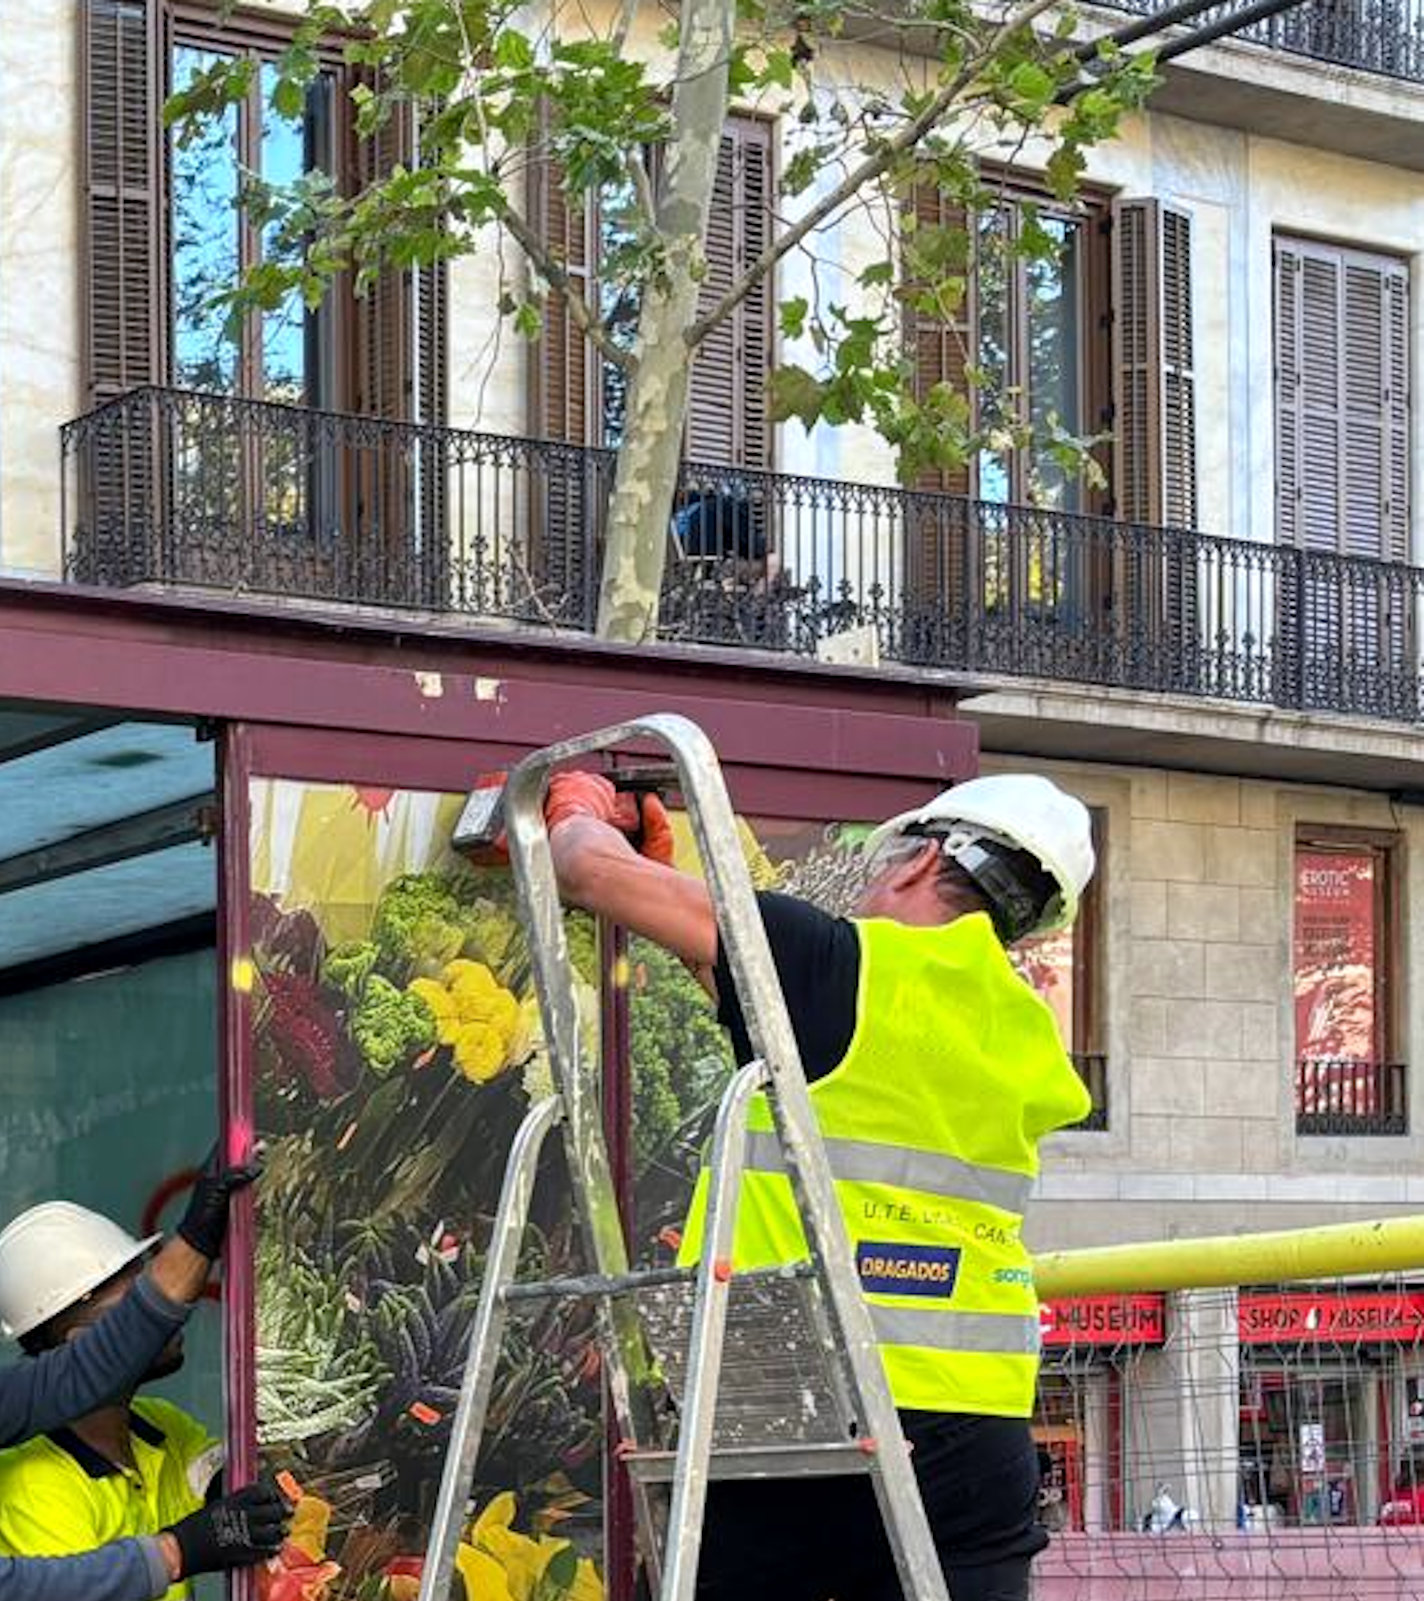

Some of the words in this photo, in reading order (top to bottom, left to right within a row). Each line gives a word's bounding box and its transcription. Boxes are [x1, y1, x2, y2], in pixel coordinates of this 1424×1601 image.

[860, 1257, 952, 1282] DRAGADOS
[1055, 1305, 1159, 1331] MUSEUM
[1250, 1308, 1300, 1329] SHOP
